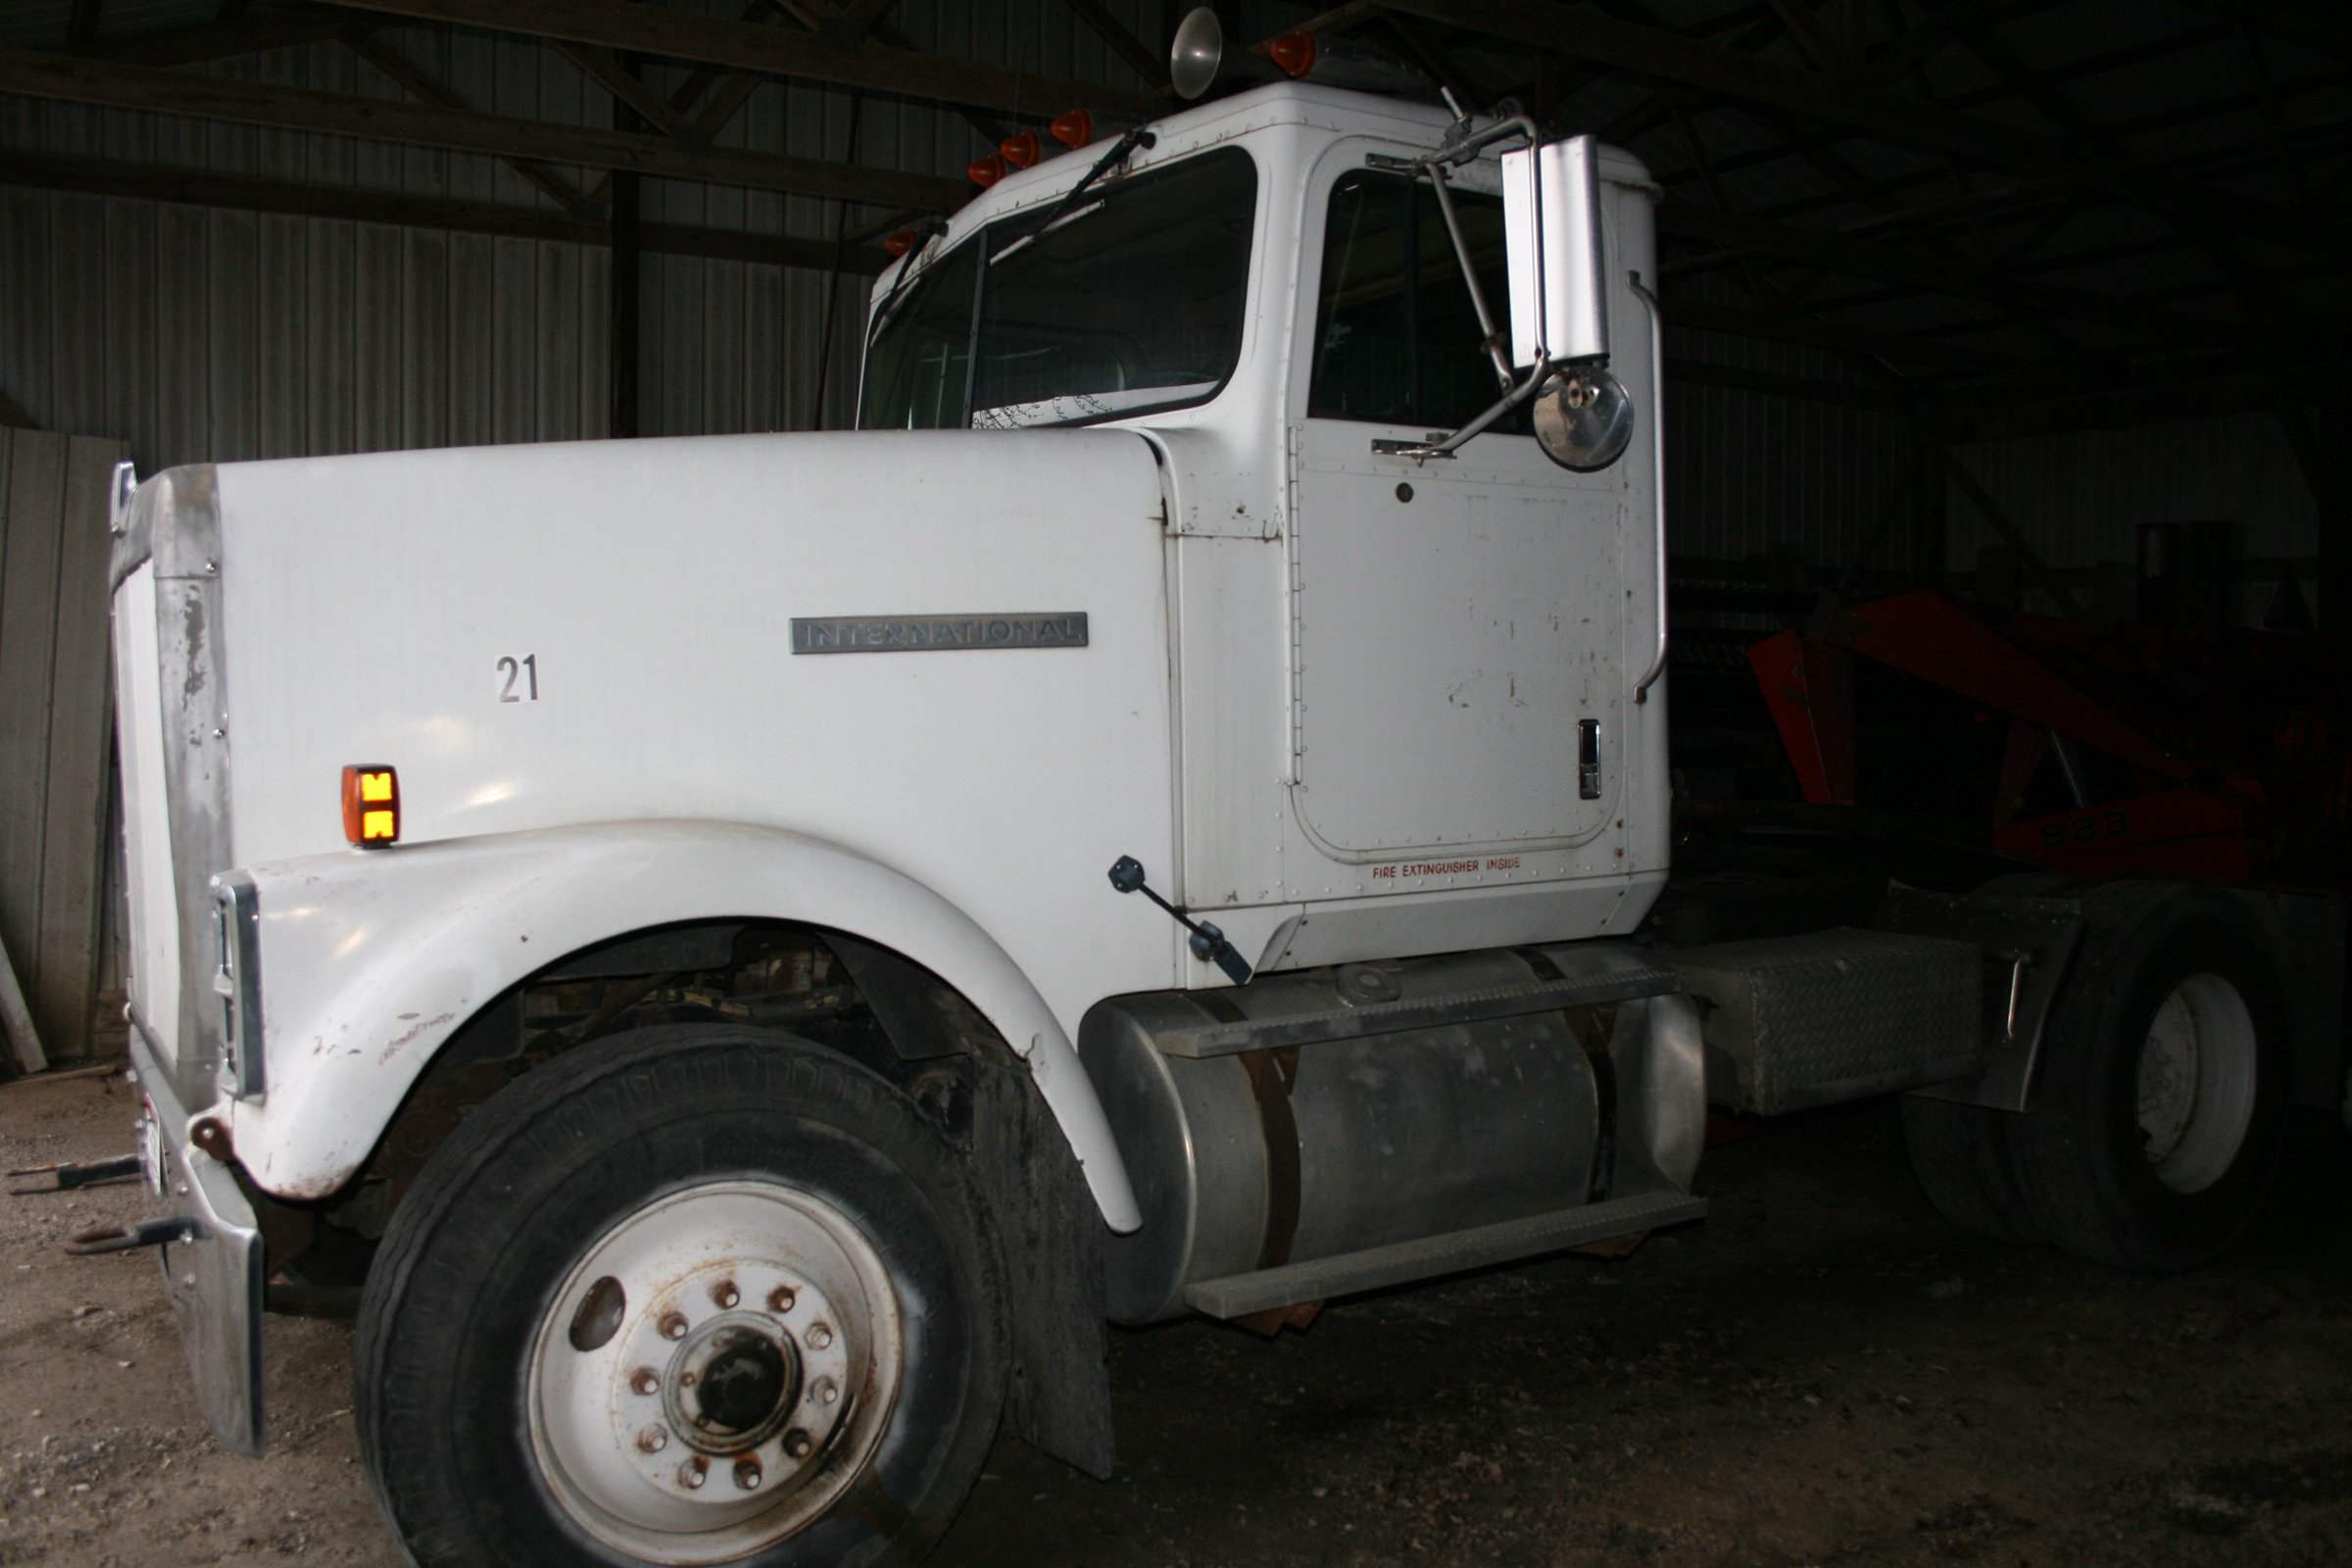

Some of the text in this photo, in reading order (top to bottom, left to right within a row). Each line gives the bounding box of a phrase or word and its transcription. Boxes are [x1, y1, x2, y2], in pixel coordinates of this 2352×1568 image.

[804, 618, 1084, 647] INTERNATIONAL
[496, 653, 538, 703] 21
[2039, 808, 2129, 849] 883
[1373, 857, 1521, 879] FIRE EXTINGUISHER INSIDE
